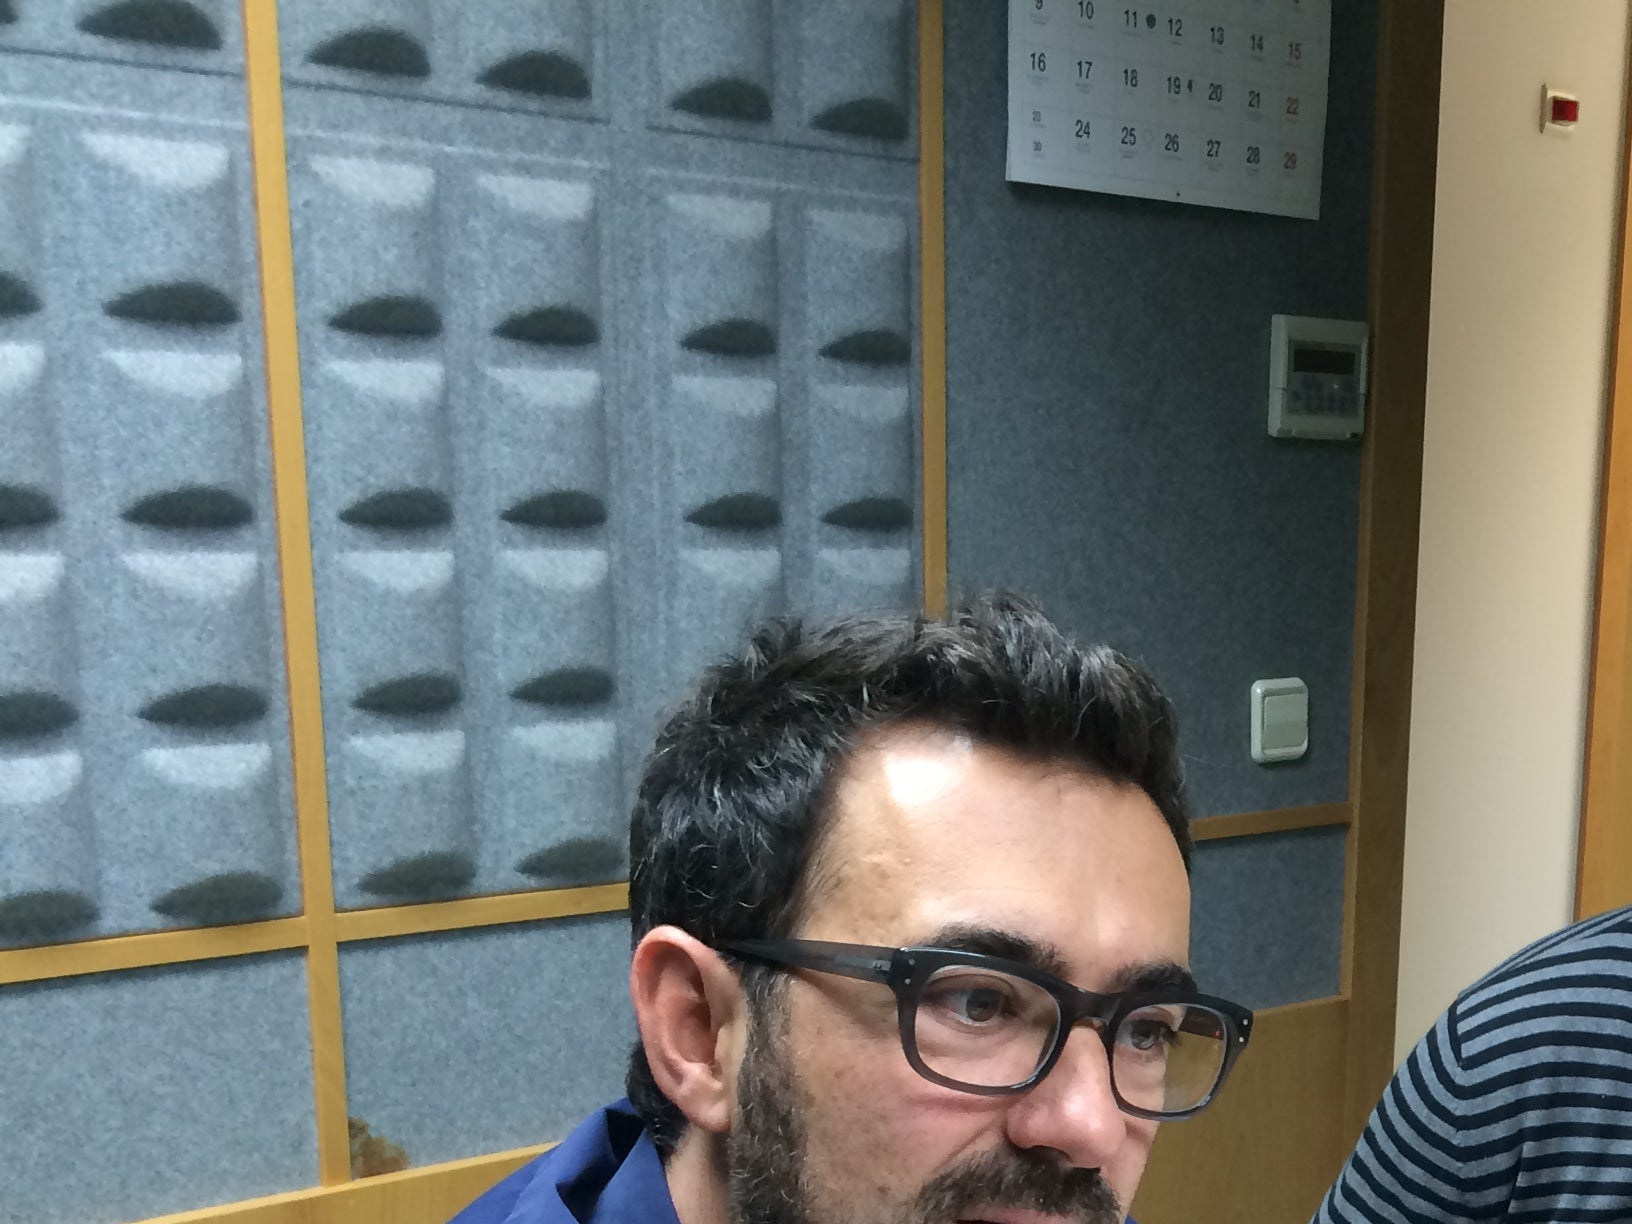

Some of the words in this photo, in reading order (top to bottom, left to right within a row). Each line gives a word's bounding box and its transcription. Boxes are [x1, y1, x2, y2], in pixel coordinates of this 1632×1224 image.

[1078, 1, 1094, 20] 10
[1124, 9, 1138, 28] 11
[1168, 17, 1183, 37] 12
[1210, 26, 1225, 46] 13
[1250, 34, 1265, 52] 14
[1288, 41, 1302, 60] 15
[1030, 52, 1047, 72] 16
[1077, 60, 1093, 79] 17
[1123, 68, 1139, 87] 18
[1167, 76, 1181, 95] 19
[1208, 82, 1223, 102] 20
[1248, 90, 1261, 109] 21
[1286, 96, 1300, 116] 22
[1075, 119, 1091, 139] 24
[1121, 126, 1137, 146] 25
[1164, 133, 1180, 153] 26
[1206, 139, 1221, 158] 27
[1246, 146, 1260, 165] 28
[1283, 152, 1298, 170] 29
